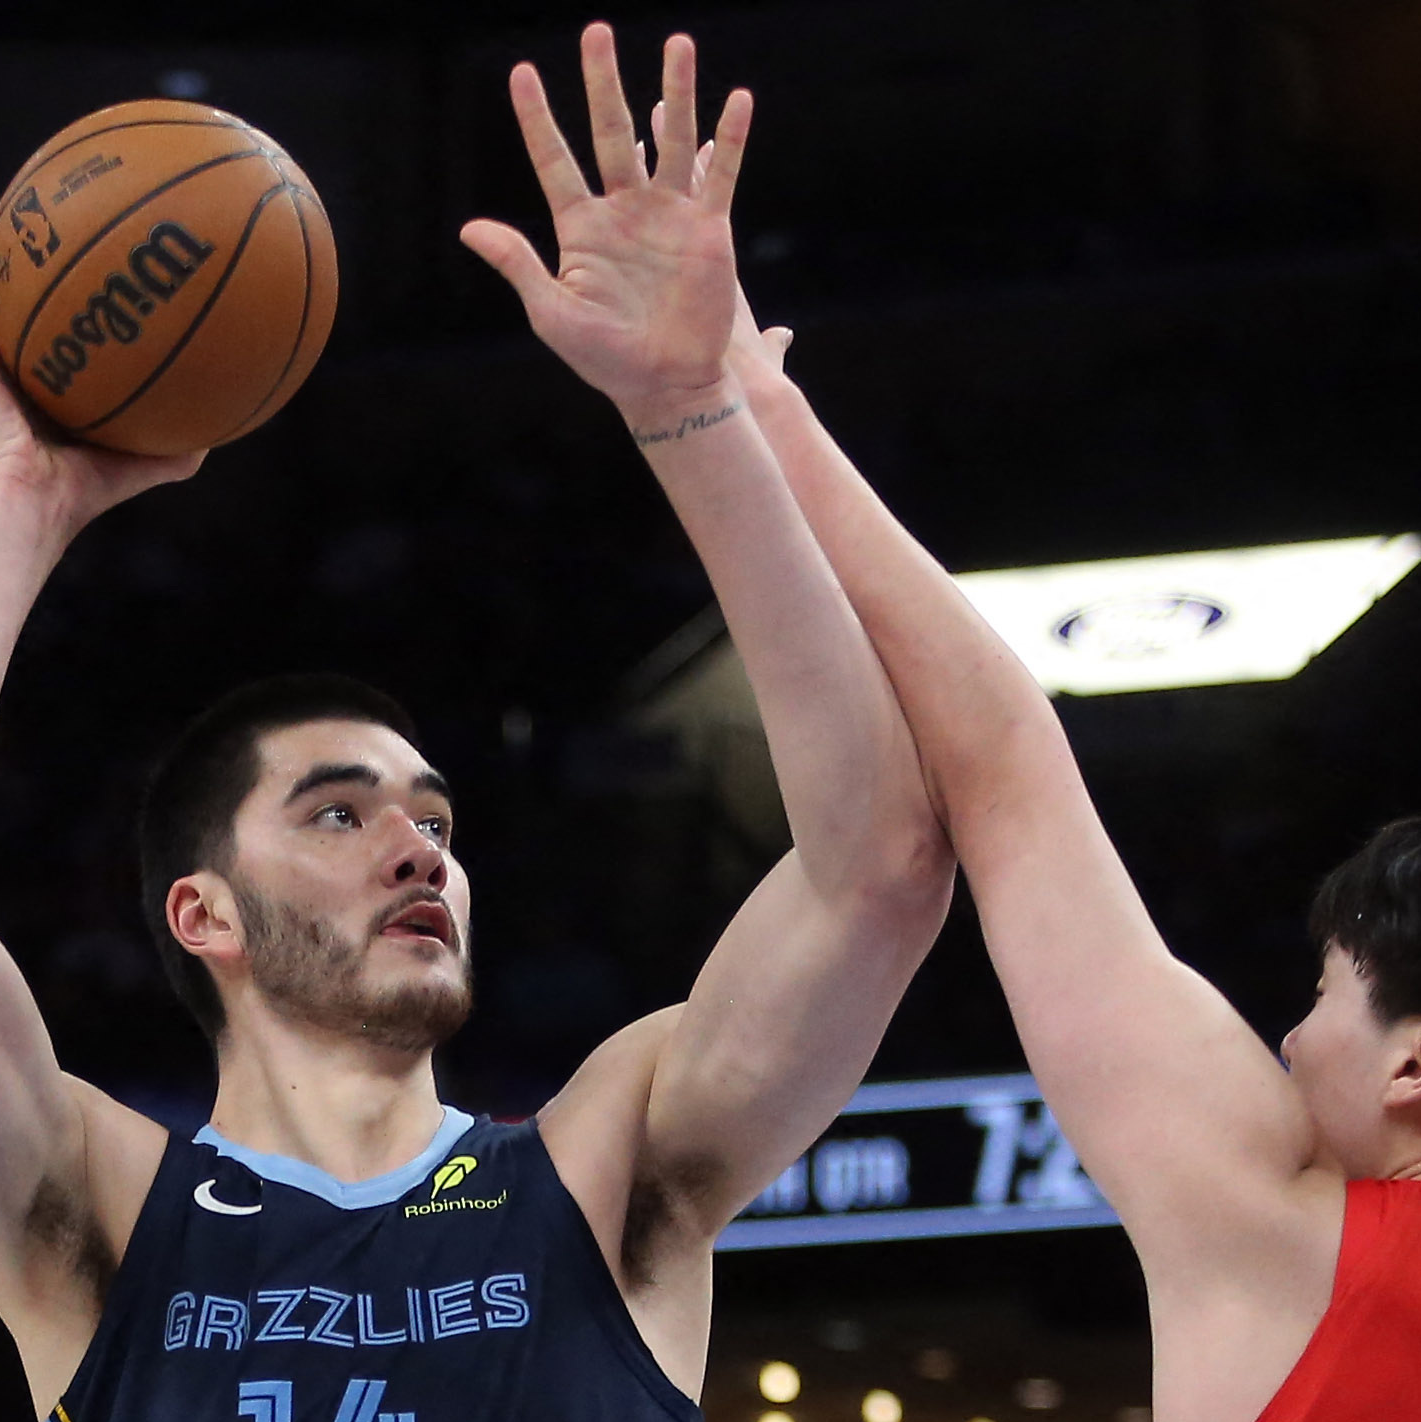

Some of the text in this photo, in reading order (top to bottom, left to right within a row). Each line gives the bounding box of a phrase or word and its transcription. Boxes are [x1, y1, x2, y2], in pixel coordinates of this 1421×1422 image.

[32, 220, 217, 396] Wilson
[404, 1188, 508, 1218] Robinhood
[164, 1273, 531, 1351] GRZZLIES
